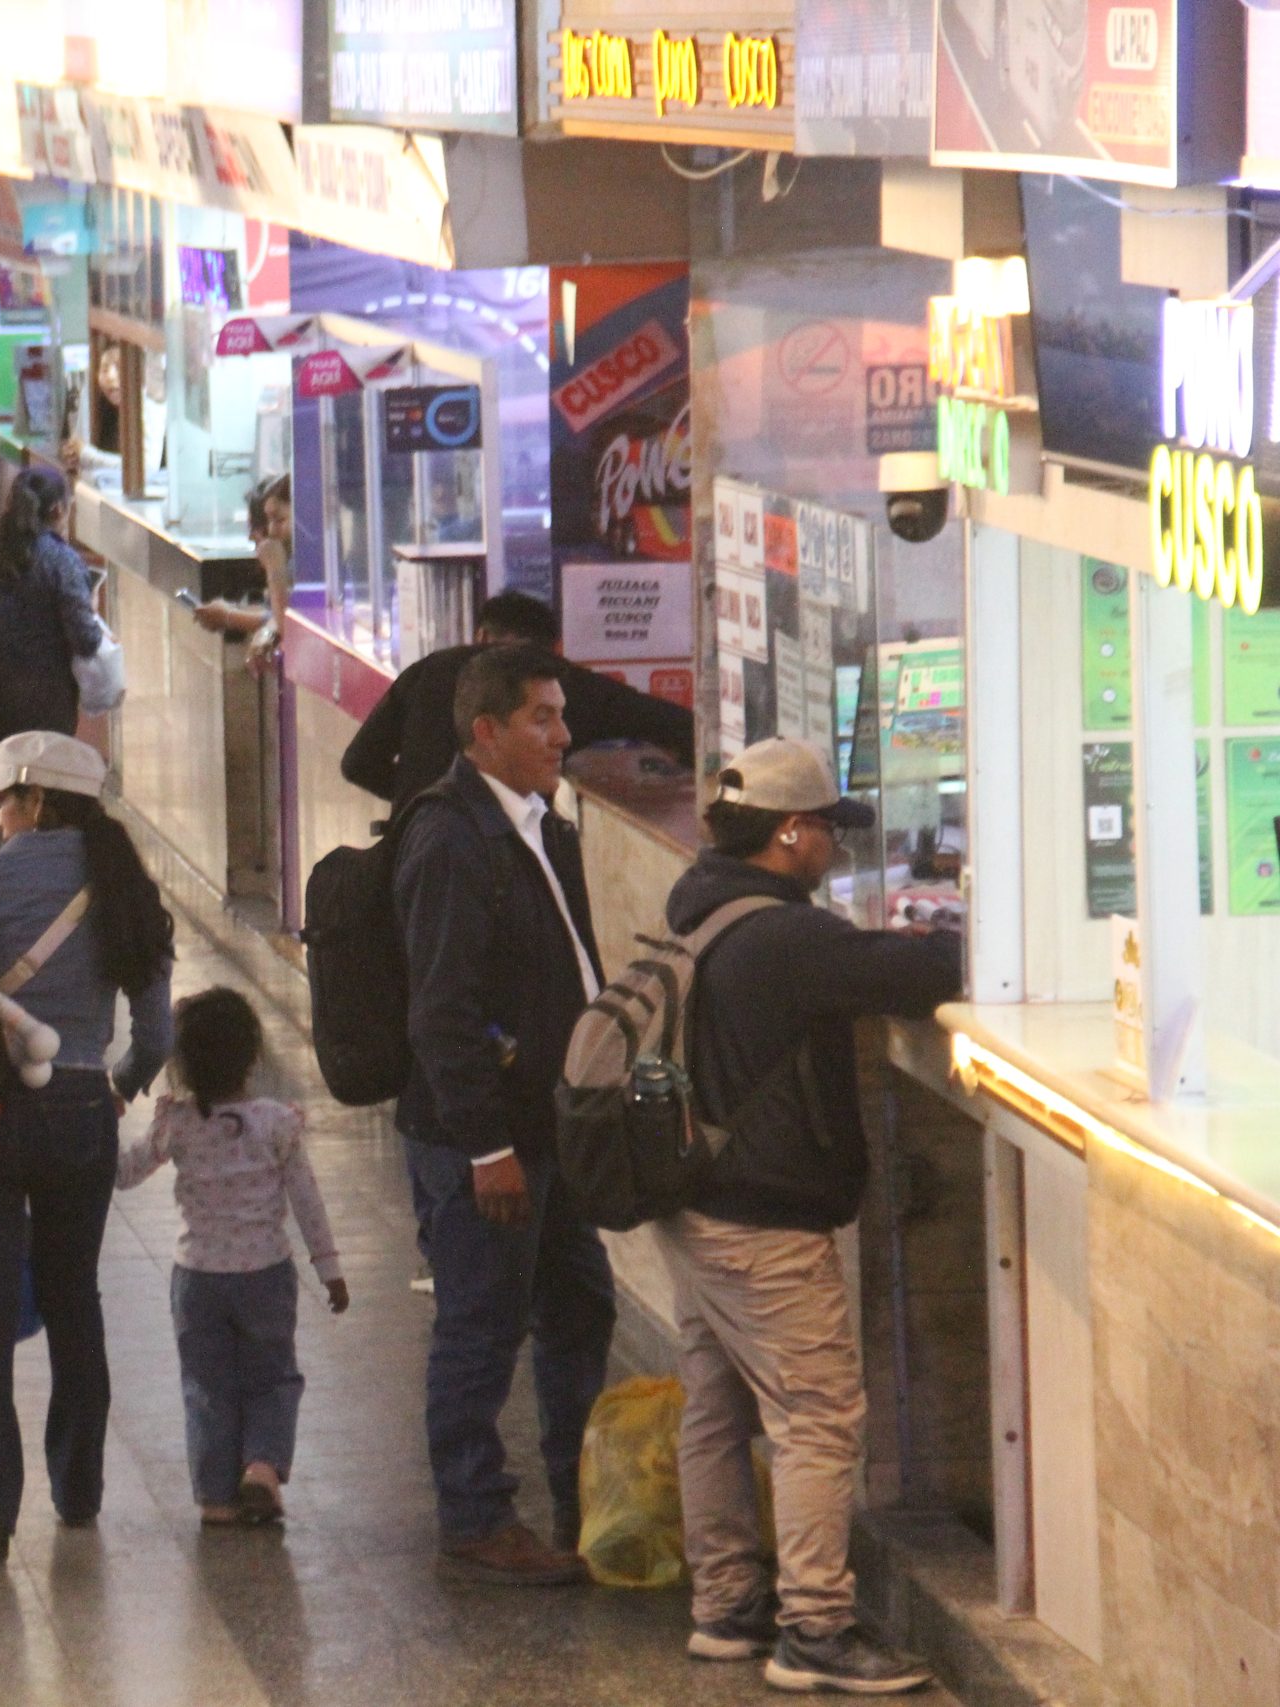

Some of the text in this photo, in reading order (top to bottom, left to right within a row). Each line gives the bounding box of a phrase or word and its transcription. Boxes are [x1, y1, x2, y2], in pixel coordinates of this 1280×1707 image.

[1113, 14, 1151, 63] LA PAZ
[560, 335, 661, 416] CUSCO
[1163, 297, 1255, 458] PUNO
[1149, 442, 1264, 616] CUSCO
[604, 612, 653, 624] CUSCO
